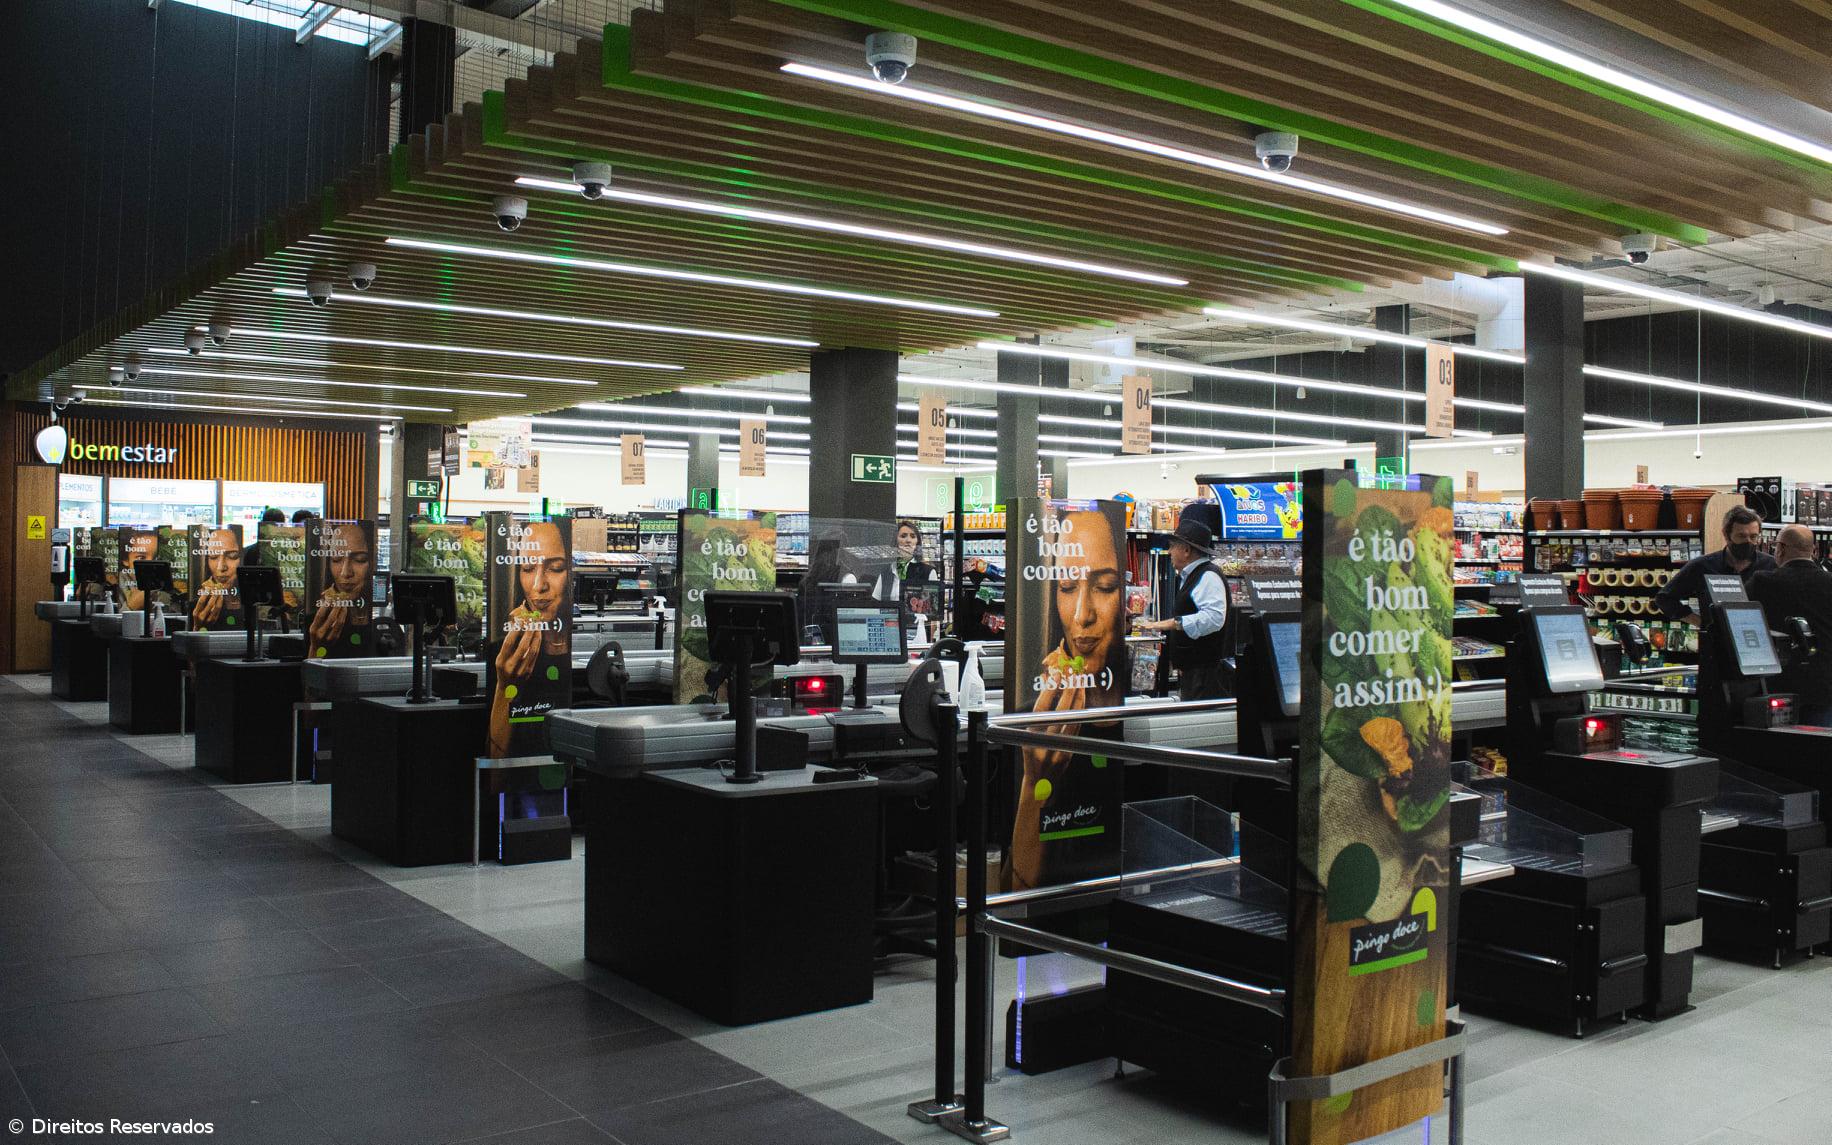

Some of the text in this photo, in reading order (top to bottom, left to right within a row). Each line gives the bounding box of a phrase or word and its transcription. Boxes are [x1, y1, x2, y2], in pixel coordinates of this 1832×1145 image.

[1440, 358, 1451, 386] 03
[1136, 387, 1150, 410] 04
[932, 408, 944, 428] 05
[752, 428, 764, 444] 06
[70, 438, 177, 463] bemestar
[632, 442, 644, 457] 07
[1026, 513, 1073, 534] é tão
[1237, 514, 1268, 524] HARIBO
[323, 526, 341, 536] tão
[498, 524, 533, 537] é tão
[320, 536, 348, 546] bom
[424, 538, 462, 551] é tão
[506, 538, 540, 550] bom
[700, 538, 748, 557] é tão
[1038, 536, 1085, 558] bom
[1349, 528, 1415, 563] é tão
[192, 548, 226, 556] comer
[311, 550, 351, 558] comer
[495, 555, 546, 565] comer
[433, 555, 469, 568] bom
[712, 562, 758, 580] bom
[1023, 565, 1090, 581] comer
[1366, 576, 1430, 611] bom
[503, 618, 550, 632] assim
[1329, 627, 1424, 658] comer
[1033, 667, 1096, 692] assim
[1042, 804, 1096, 832] pingo doce
[1354, 920, 1420, 963] pingo doce
